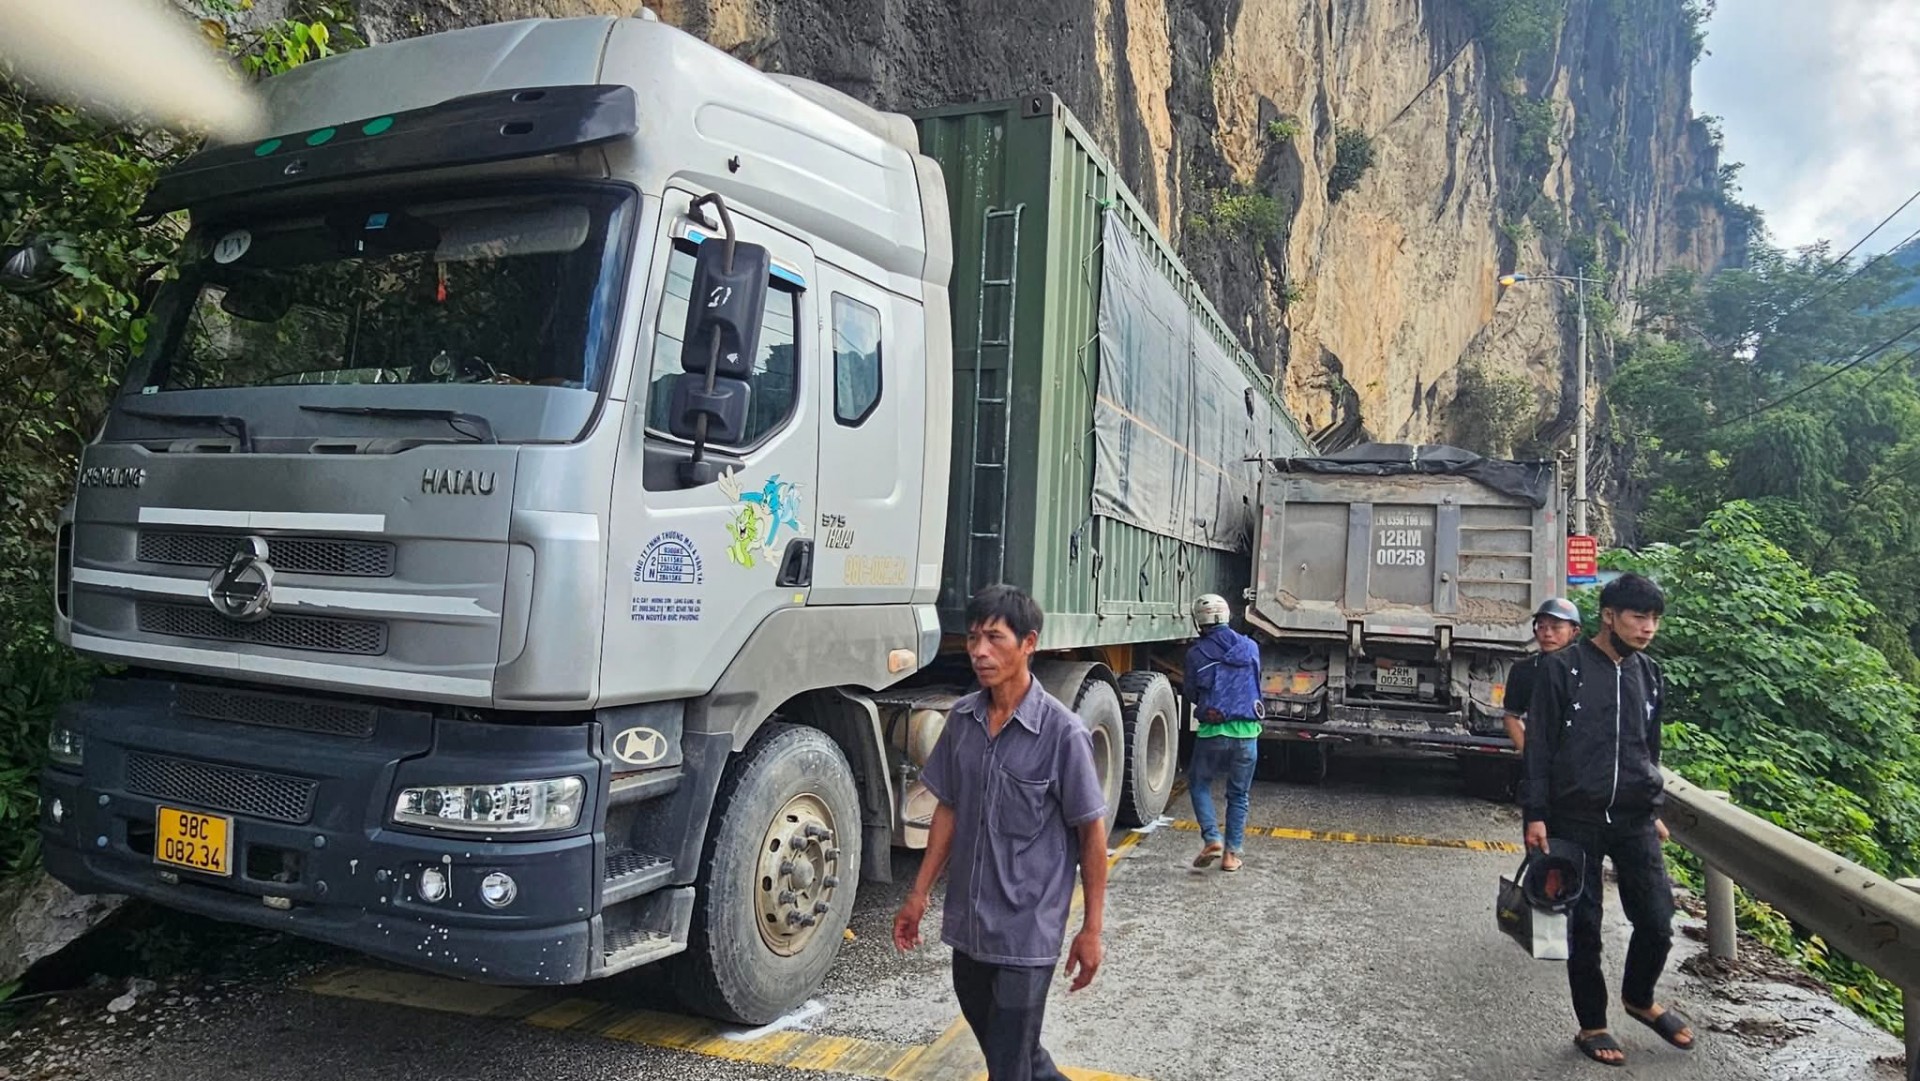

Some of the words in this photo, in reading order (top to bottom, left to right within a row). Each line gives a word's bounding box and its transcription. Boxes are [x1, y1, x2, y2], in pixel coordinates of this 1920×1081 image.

[421, 468, 499, 496] HAIAU
[1379, 529, 1421, 546] 12RM
[641, 549, 648, 559] TY
[651, 556, 657, 567] 2
[1377, 549, 1425, 565] 00258
[649, 568, 656, 579] N
[180, 814, 209, 840] 98C
[166, 837, 219, 869] 082.34
